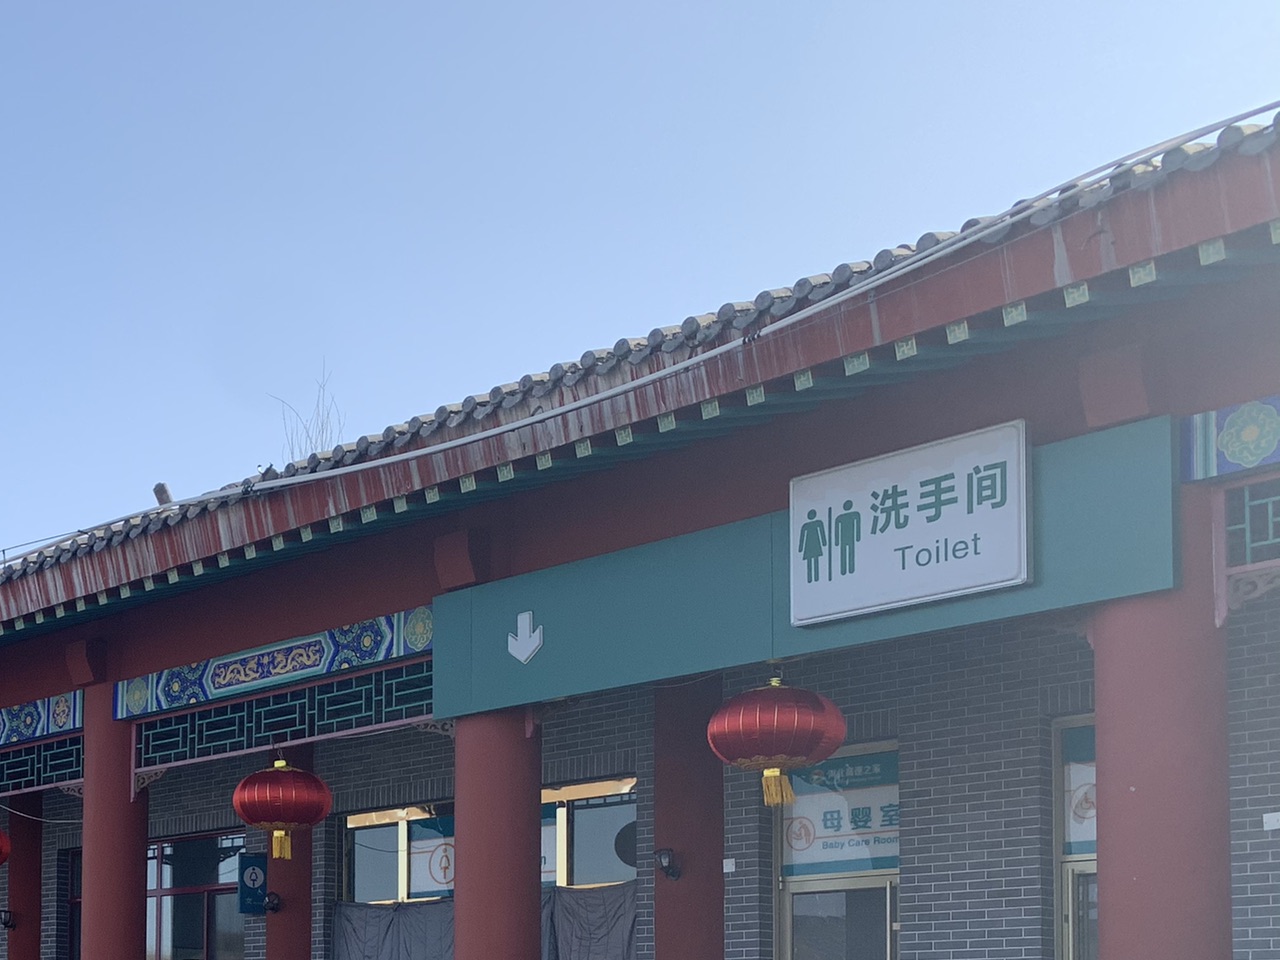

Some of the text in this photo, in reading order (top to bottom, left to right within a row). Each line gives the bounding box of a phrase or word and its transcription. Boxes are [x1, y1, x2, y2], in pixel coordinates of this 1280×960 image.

[870, 460, 1007, 535] 洗手间
[894, 533, 981, 570] Toilet
[822, 803, 899, 832] 母婴室
[822, 841, 845, 850] Baby
[848, 838, 870, 847] Care
